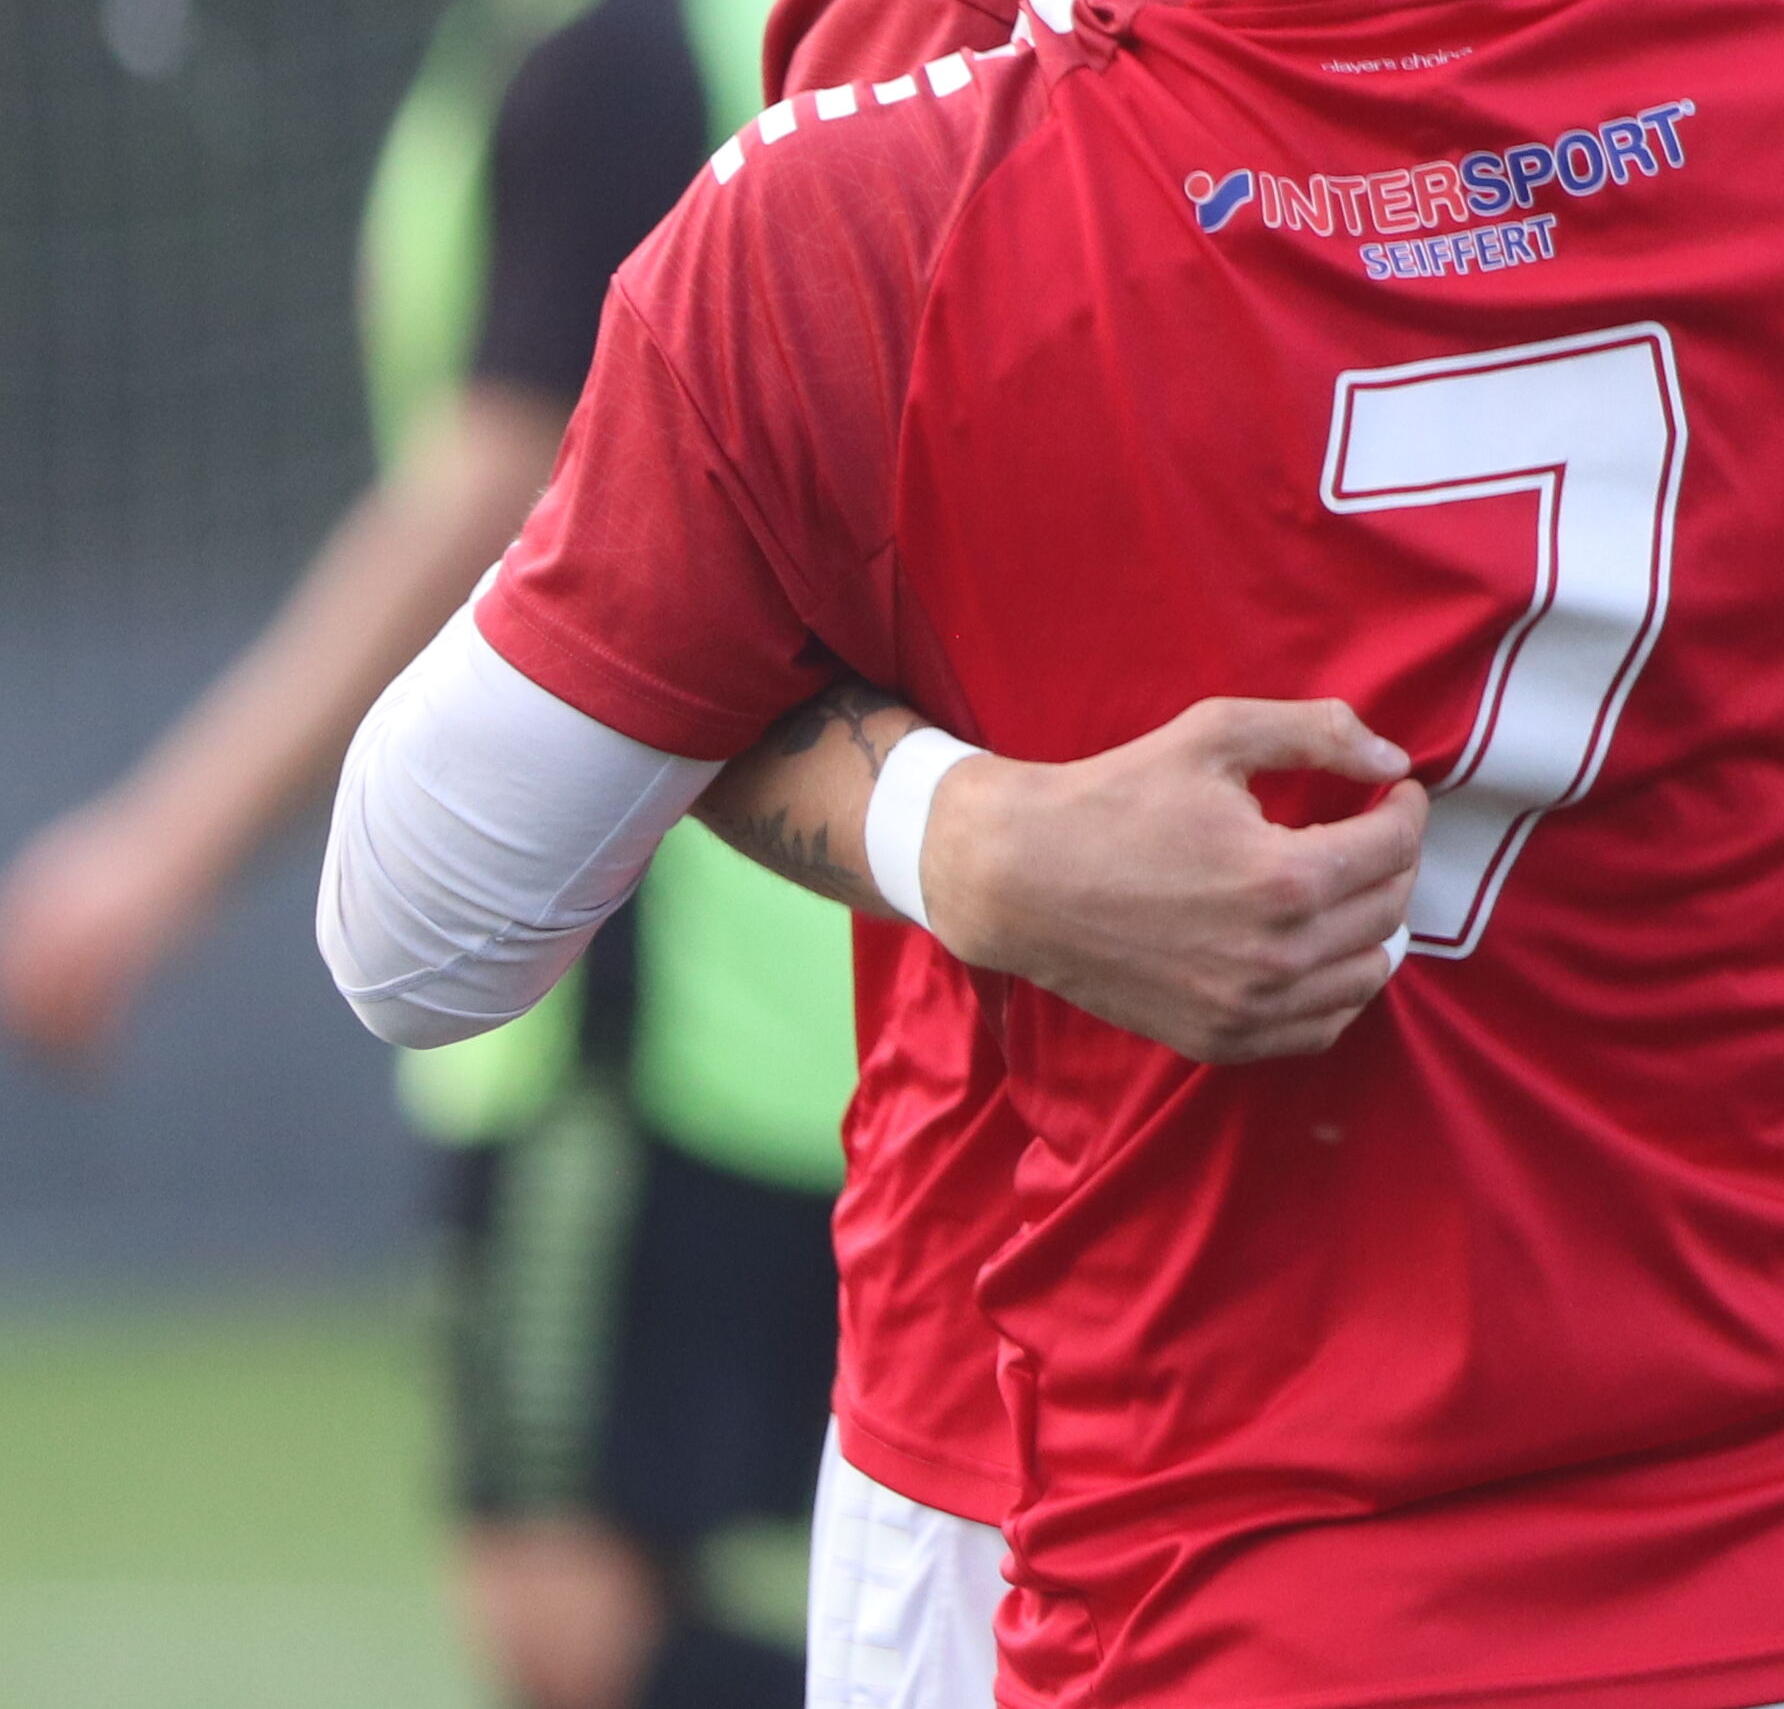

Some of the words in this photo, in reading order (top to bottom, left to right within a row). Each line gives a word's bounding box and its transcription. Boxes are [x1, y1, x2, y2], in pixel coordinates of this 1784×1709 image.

[1258, 102, 1687, 237] INTERSPORT
[1359, 213, 1557, 281] SEIFFERT
[1319, 320, 1688, 959] 7
